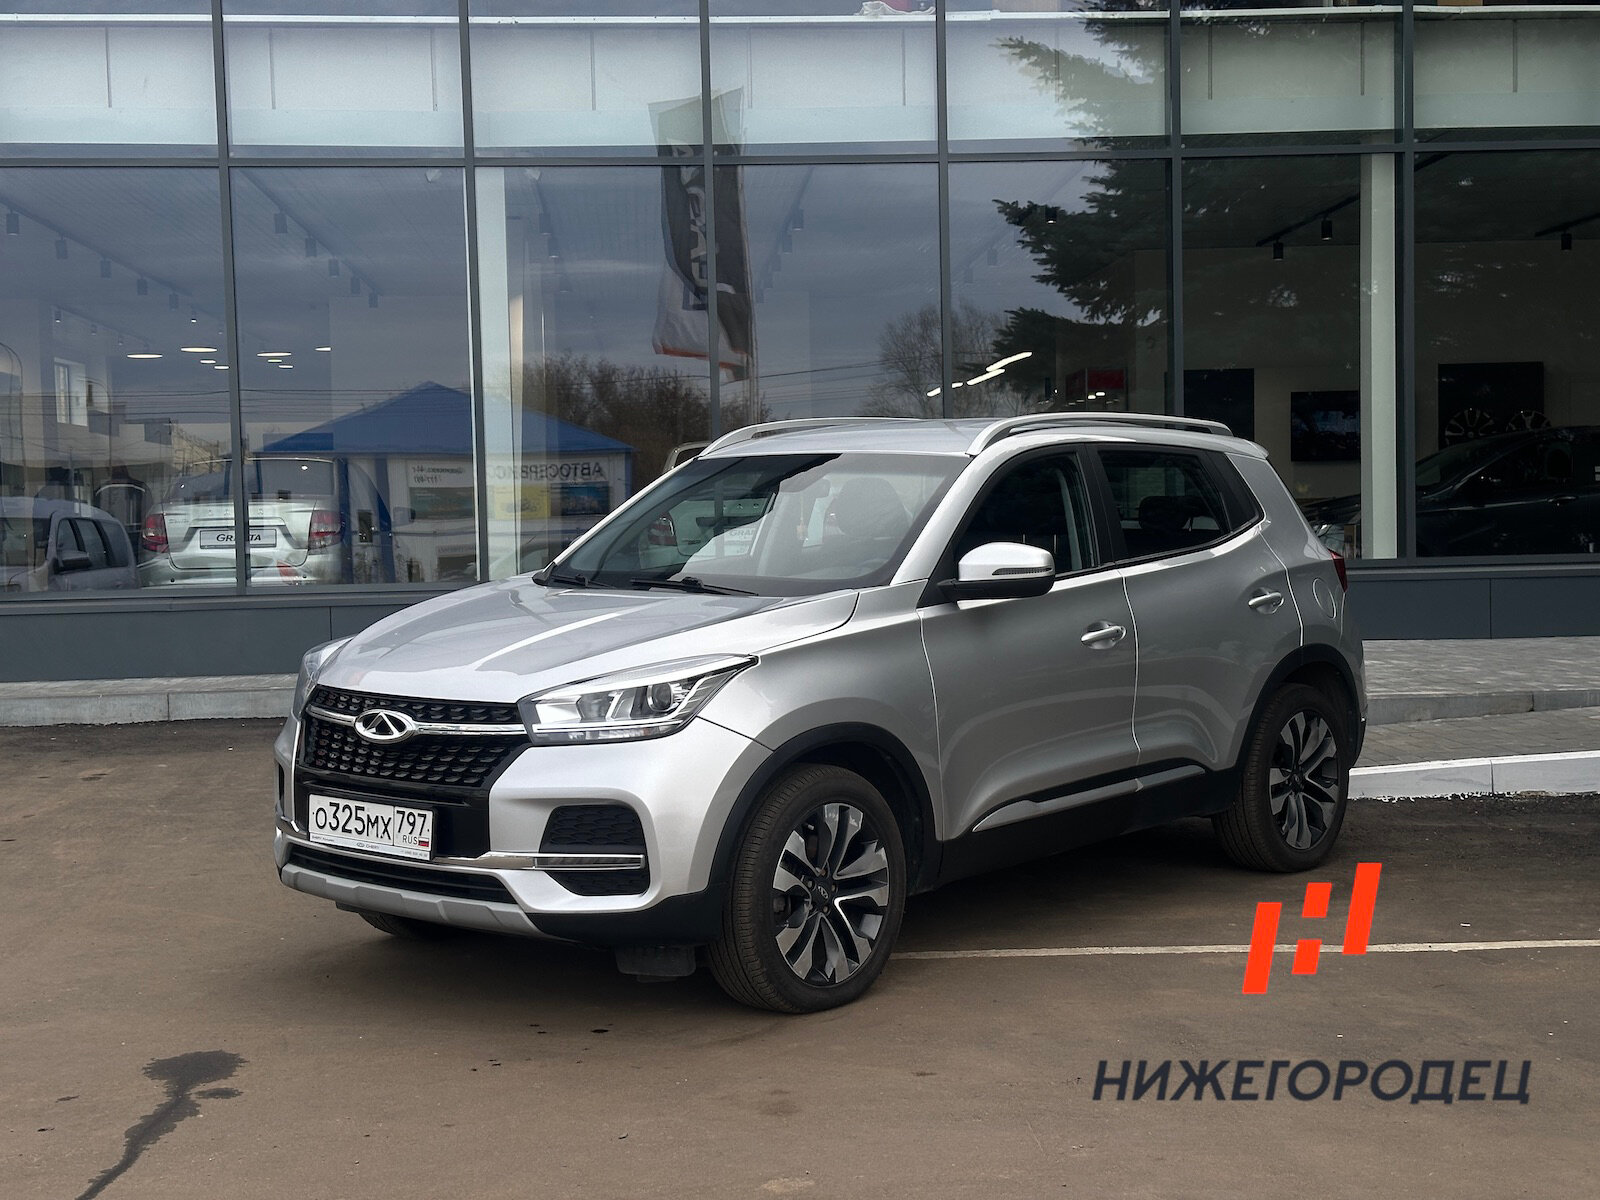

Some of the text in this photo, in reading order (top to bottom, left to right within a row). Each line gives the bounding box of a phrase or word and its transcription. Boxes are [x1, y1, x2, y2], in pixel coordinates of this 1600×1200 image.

[216, 533, 262, 542] GRTA
[396, 809, 427, 837] 797
[402, 834, 418, 845] RUS
